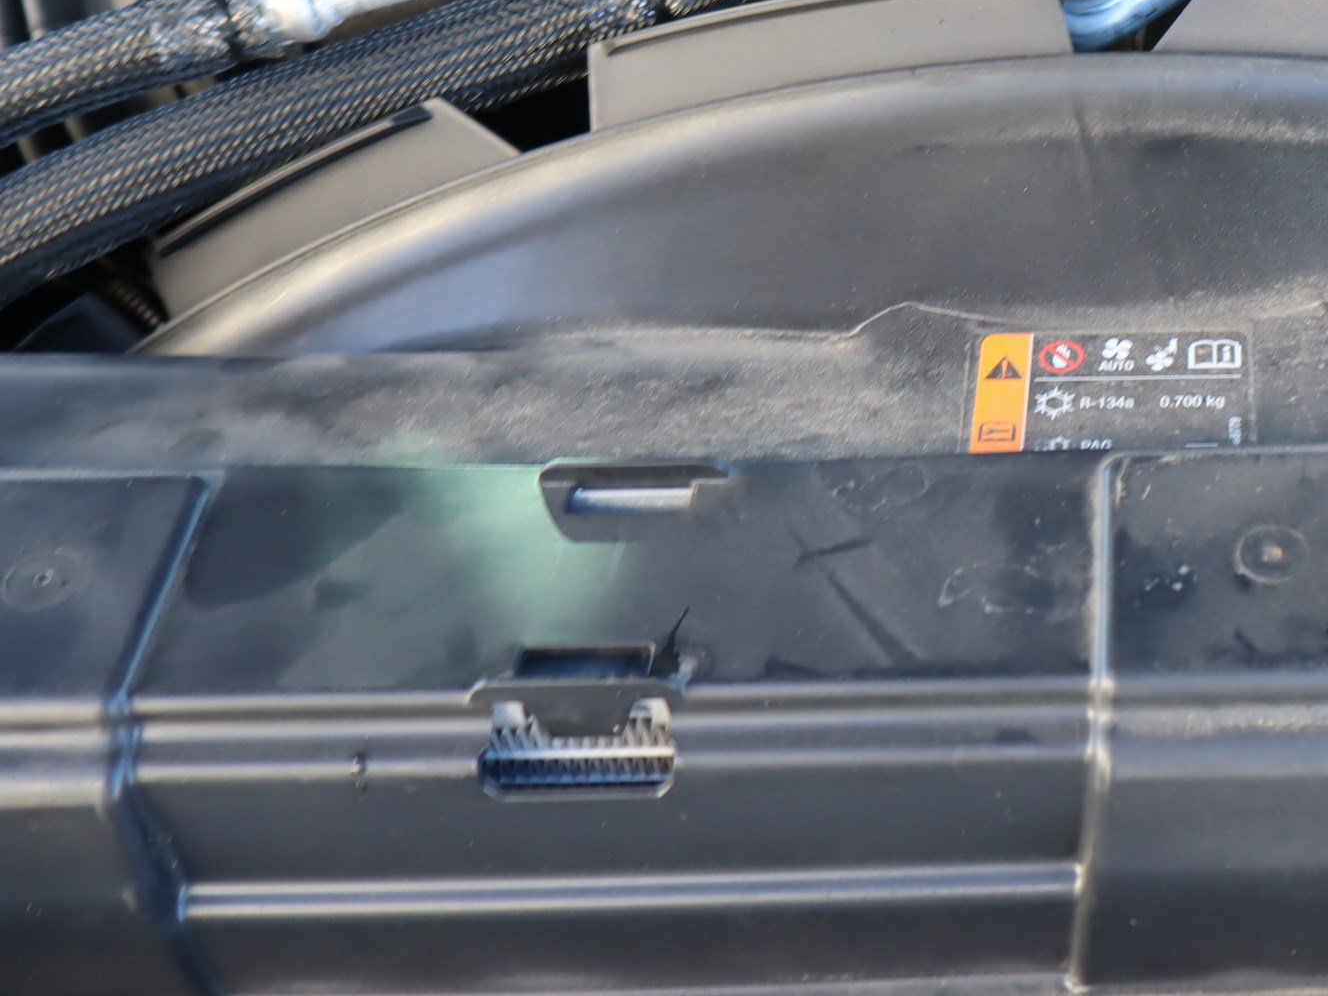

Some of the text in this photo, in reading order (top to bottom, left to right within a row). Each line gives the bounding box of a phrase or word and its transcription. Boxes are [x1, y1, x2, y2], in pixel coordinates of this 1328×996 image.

[1098, 359, 1135, 372] AUTO
[1079, 394, 1227, 411] R-134a 0.700 kg
